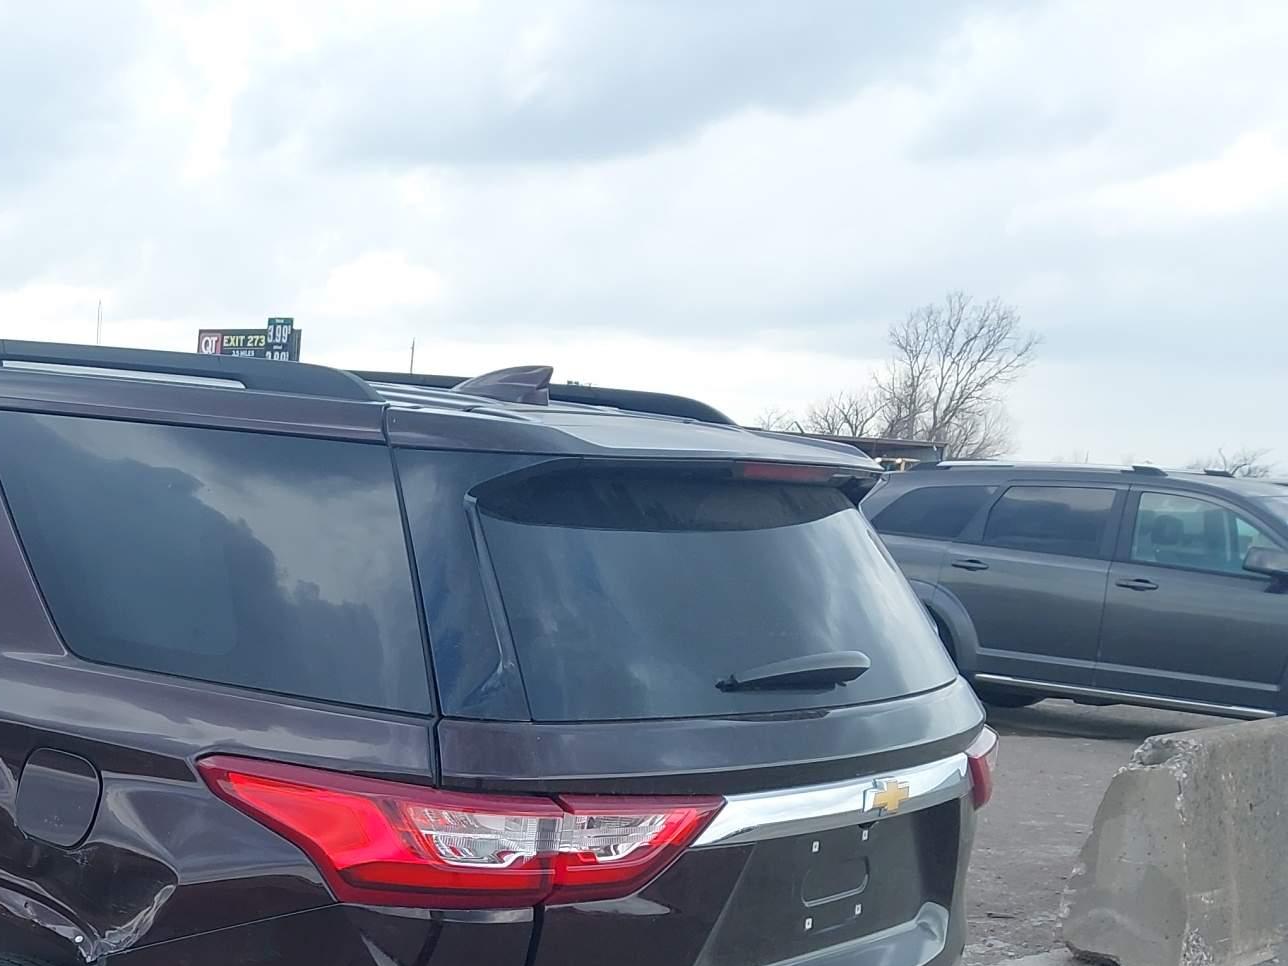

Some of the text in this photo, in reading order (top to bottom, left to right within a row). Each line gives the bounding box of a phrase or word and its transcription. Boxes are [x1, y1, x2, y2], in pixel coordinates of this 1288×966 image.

[201, 336, 218, 354] QT
[223, 335, 266, 347] EXIT 273
